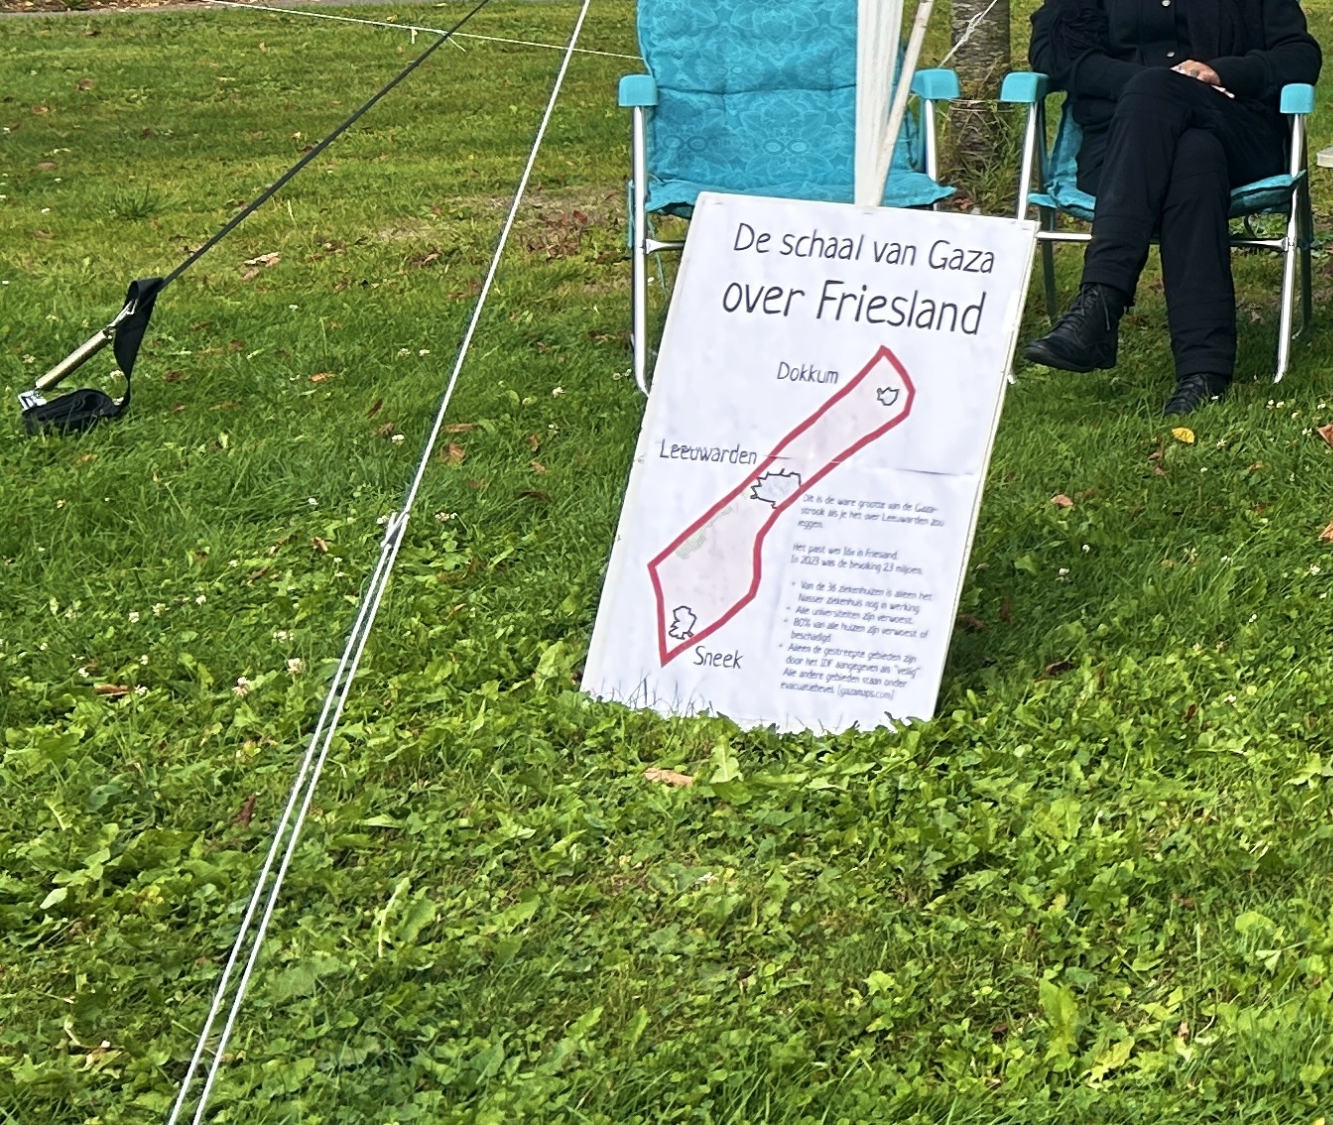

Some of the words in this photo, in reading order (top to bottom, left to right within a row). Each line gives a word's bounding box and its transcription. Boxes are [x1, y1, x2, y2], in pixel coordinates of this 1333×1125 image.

[733, 223, 771, 253] De
[779, 229, 865, 261] schaal
[873, 241, 916, 266] van
[928, 240, 995, 274] Gaza
[723, 281, 805, 317] over
[816, 280, 986, 335] Friesland
[777, 362, 838, 384] Dokkum
[659, 438, 758, 465] Leeuwarden
[824, 496, 835, 504] de
[902, 502, 912, 511] de
[838, 510, 848, 520] je
[849, 511, 862, 520] het
[882, 512, 929, 526] Leeuwarden
[808, 546, 826, 555] past
[800, 555, 820, 566] 2023
[837, 559, 848, 568] de
[816, 582, 826, 591] de
[826, 581, 838, 592] 36
[865, 600, 880, 612] nog
[793, 617, 811, 628] 80%
[812, 645, 822, 654] de
[692, 645, 744, 670] Sneek
[786, 655, 804, 665] door
[805, 658, 818, 666] het
[820, 658, 834, 668] IDF
